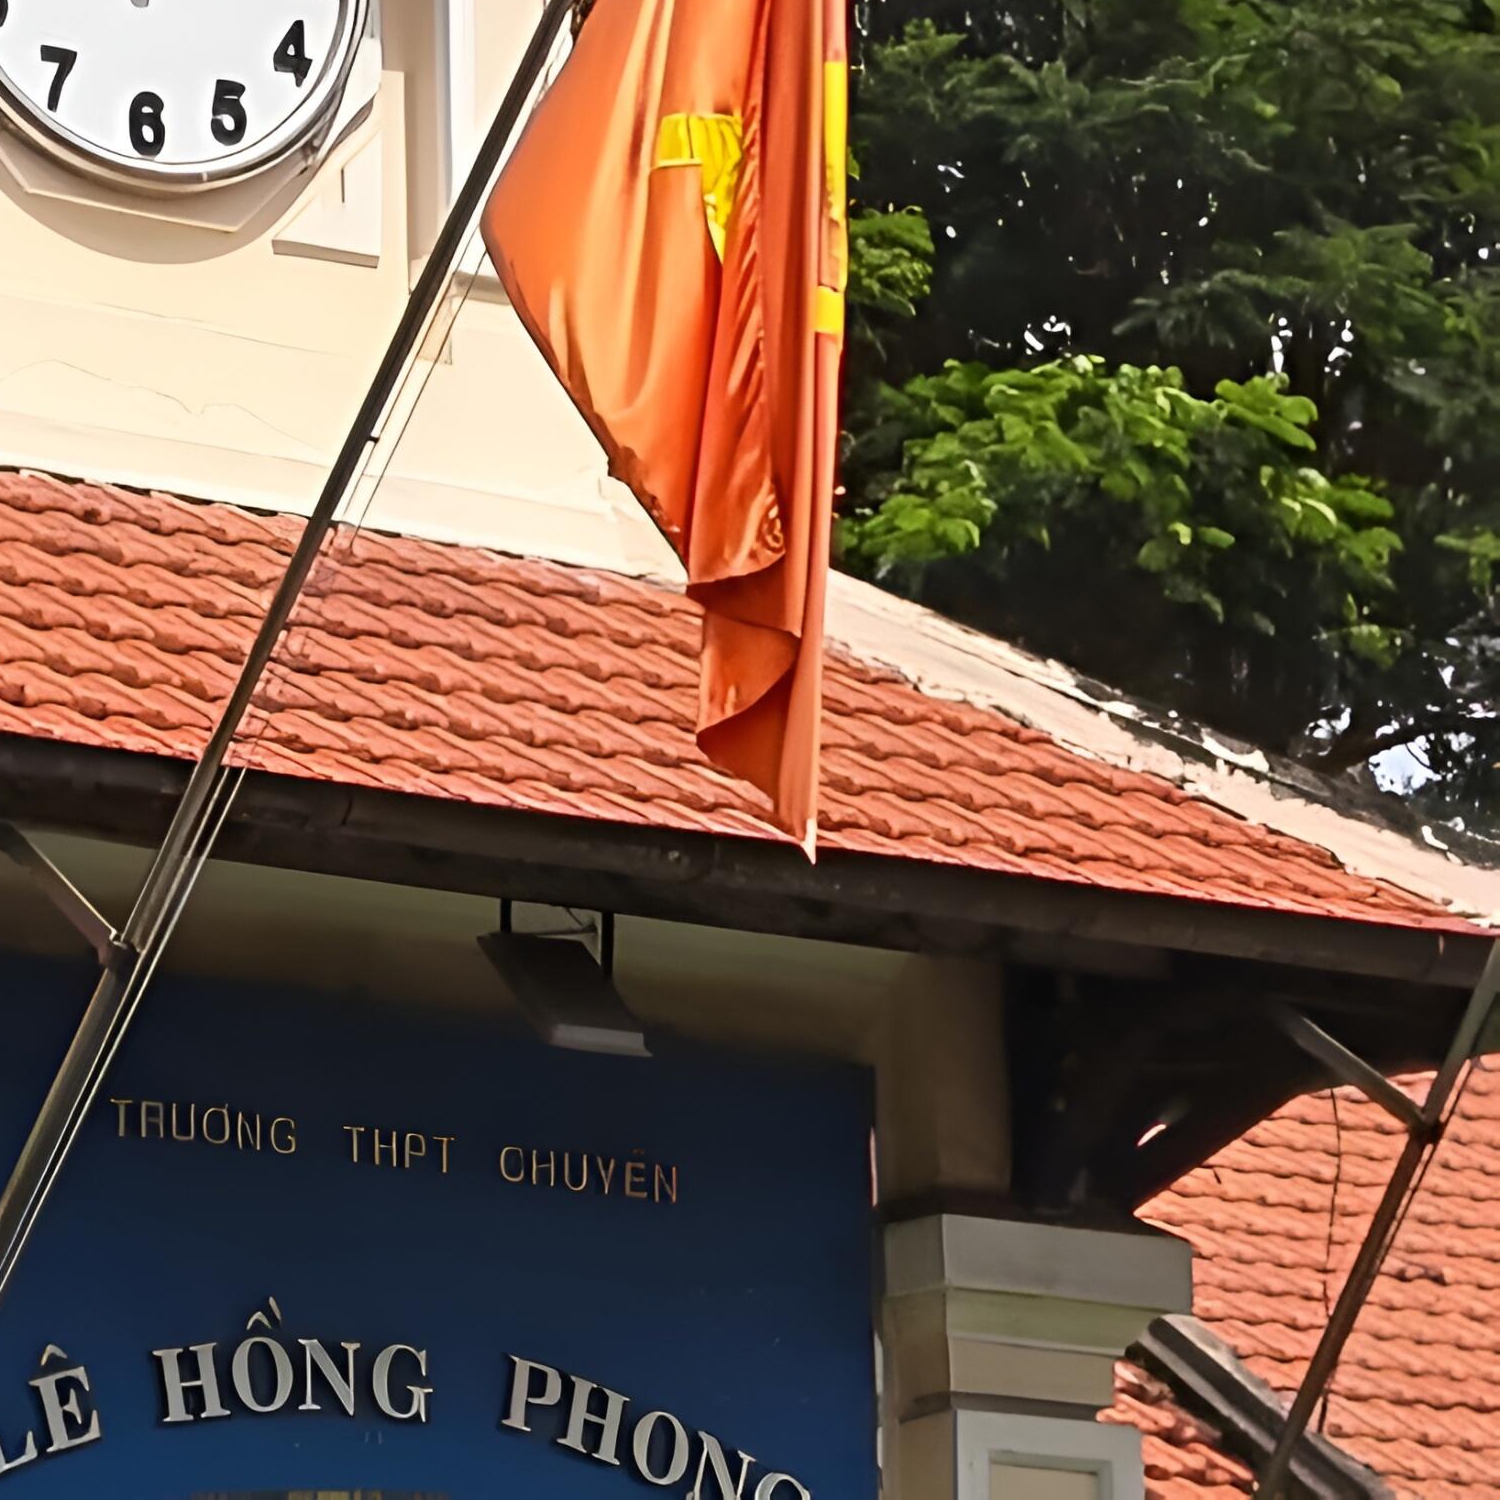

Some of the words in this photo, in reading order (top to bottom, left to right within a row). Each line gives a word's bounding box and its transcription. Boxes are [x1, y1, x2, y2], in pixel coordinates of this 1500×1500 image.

[40, 44, 78, 112] 7
[273, 19, 313, 88] 4
[128, 91, 166, 159] 6
[211, 79, 247, 146] 5
[343, 1126, 456, 1173] THPT
[152, 1296, 434, 1423] HỒNG
